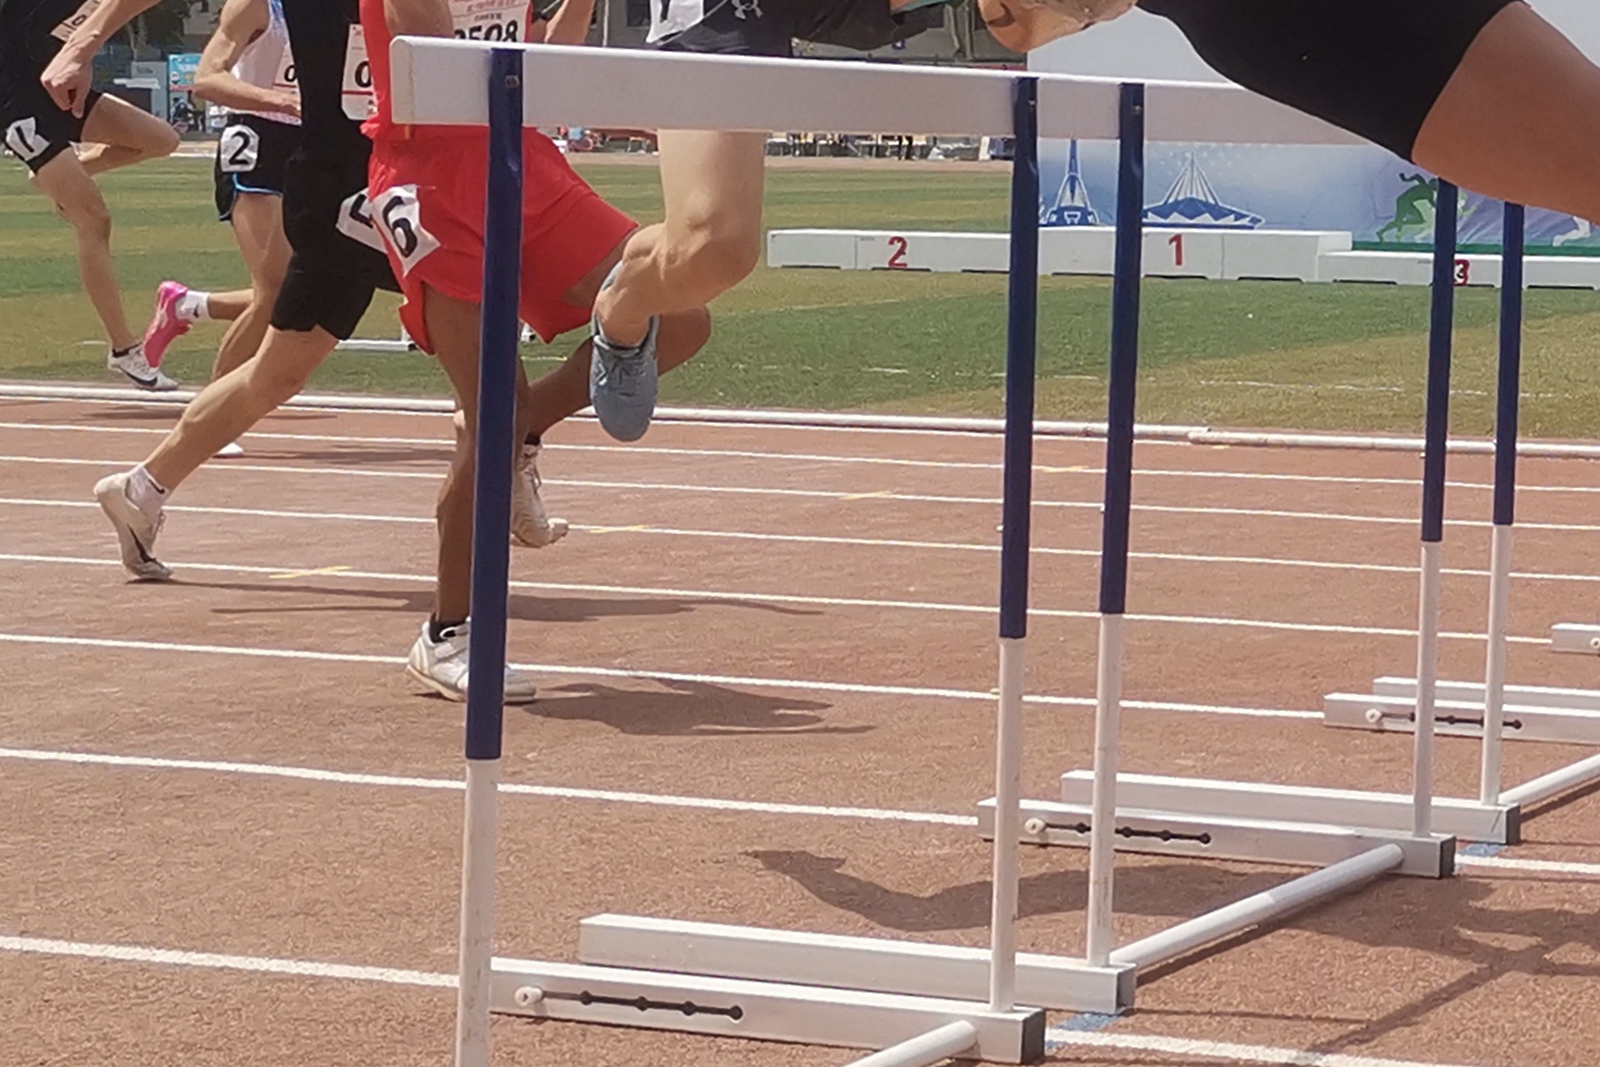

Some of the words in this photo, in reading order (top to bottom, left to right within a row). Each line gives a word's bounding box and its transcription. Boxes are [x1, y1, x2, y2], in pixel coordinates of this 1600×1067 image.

[15, 125, 35, 153] 1
[228, 131, 250, 166] 2
[383, 195, 418, 259] 6
[888, 236, 908, 268] 2
[1168, 234, 1182, 265] 1
[1453, 259, 1470, 286] 3
